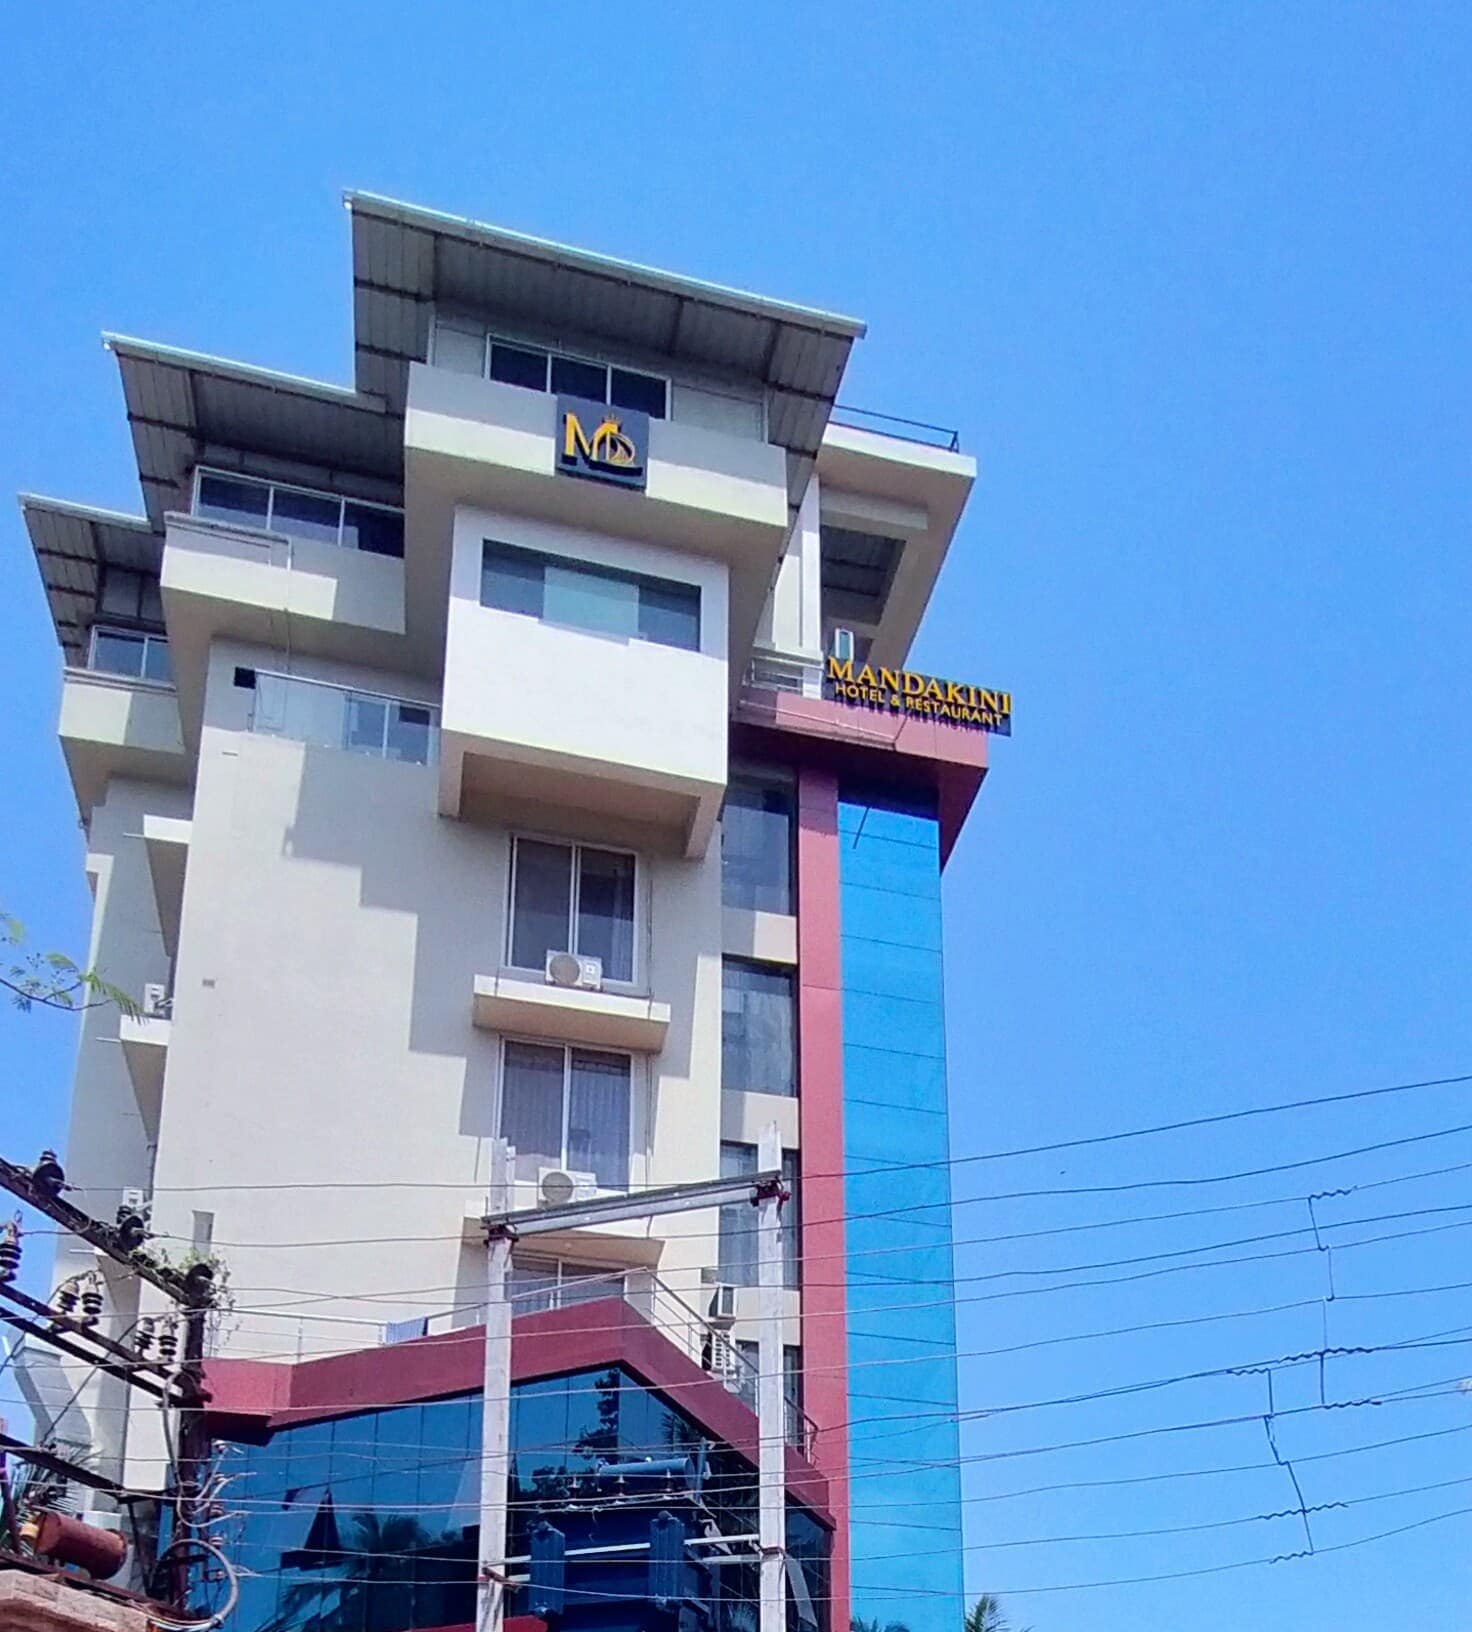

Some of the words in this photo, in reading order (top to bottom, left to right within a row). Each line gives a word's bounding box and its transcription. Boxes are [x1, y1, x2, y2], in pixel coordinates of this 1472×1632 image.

[827, 656, 1012, 714] MANDAKINI
[835, 682, 885, 703] HOTEL
[890, 694, 900, 707] &
[905, 697, 1003, 726] RESTAURANT
